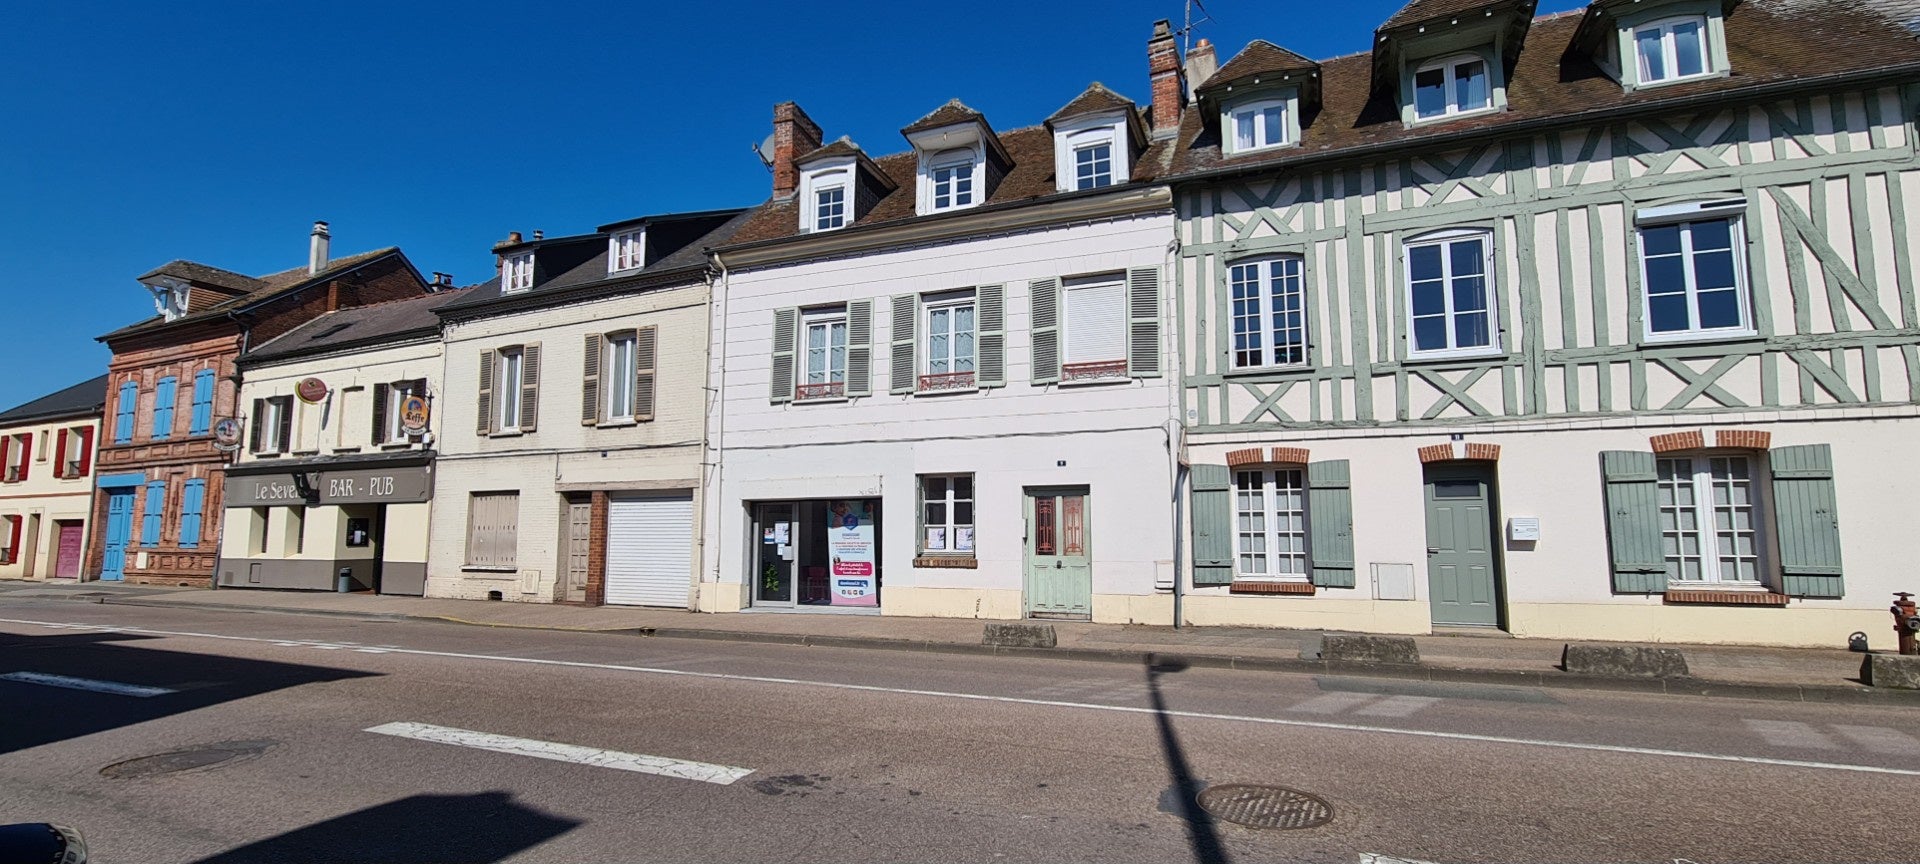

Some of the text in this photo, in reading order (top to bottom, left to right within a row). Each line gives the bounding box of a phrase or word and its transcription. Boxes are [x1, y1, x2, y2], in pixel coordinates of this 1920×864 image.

[405, 411, 425, 423] Leffe
[255, 482, 268, 500] Le
[329, 478, 354, 497] BAR
[369, 476, 394, 496] PUB
